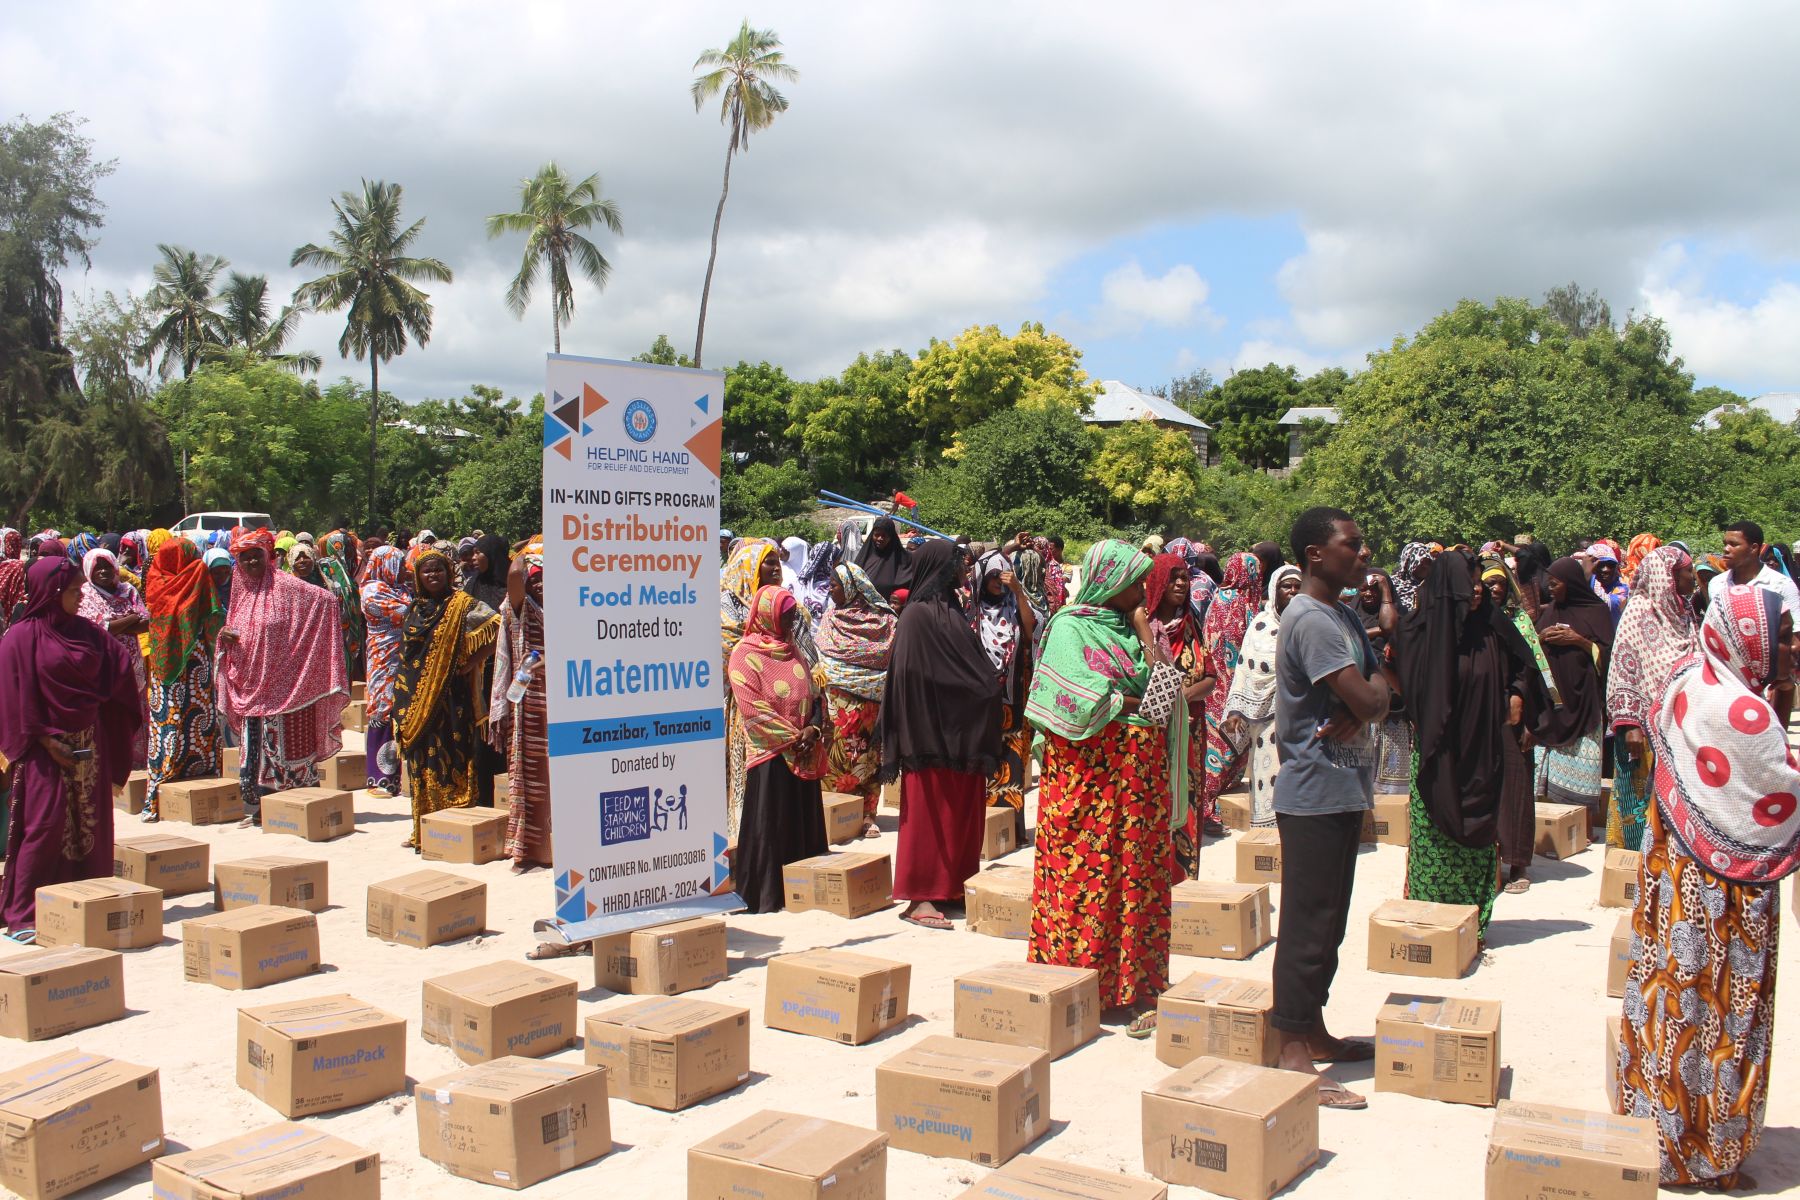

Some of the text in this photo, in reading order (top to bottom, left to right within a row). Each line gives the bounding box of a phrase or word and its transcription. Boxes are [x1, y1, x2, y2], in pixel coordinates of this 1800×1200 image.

[587, 447, 690, 465] HELPING HAND
[588, 462, 689, 475] FOR RELIEF AND DEVELOPMENT
[550, 488, 715, 508] IN-KIND GIFTS PROGRAM
[562, 513, 708, 542] Distribution
[572, 545, 702, 579] Ceremony
[579, 582, 697, 607] Food Meals
[597, 616, 683, 640] Donated to:
[566, 659, 710, 698] Matemwe
[582, 715, 711, 744] Zanzibar, Tanzania
[612, 751, 676, 774] Donated by
[604, 795, 646, 814] FEED MY
[604, 809, 646, 827] STARVING
[428, 828, 463, 843] MannaPack
[604, 822, 647, 840] CHILDREN
[159, 860, 200, 874] MannaPack
[589, 848, 706, 883] CONTAINER No. MIEU0030816
[602, 892, 631, 914] HHRD
[632, 885, 667, 908] AFRICA
[674, 879, 698, 899] 2024
[438, 916, 476, 936] MannaPack
[258, 949, 308, 972] MannaPack
[48, 976, 111, 1002] MannaPack
[959, 983, 993, 995] MannaPack
[782, 1000, 840, 1025] MannaPack
[506, 1021, 562, 1051] MannaPack
[588, 1037, 623, 1053] MannaPack
[312, 1044, 385, 1072] MannaPack
[47, 1102, 92, 1125] MannaPack
[894, 1113, 972, 1143] MannaPack
[1504, 1149, 1561, 1169] MannaPack
[1542, 1185, 1556, 1193] SITE
[1557, 1188, 1577, 1197] CODE
